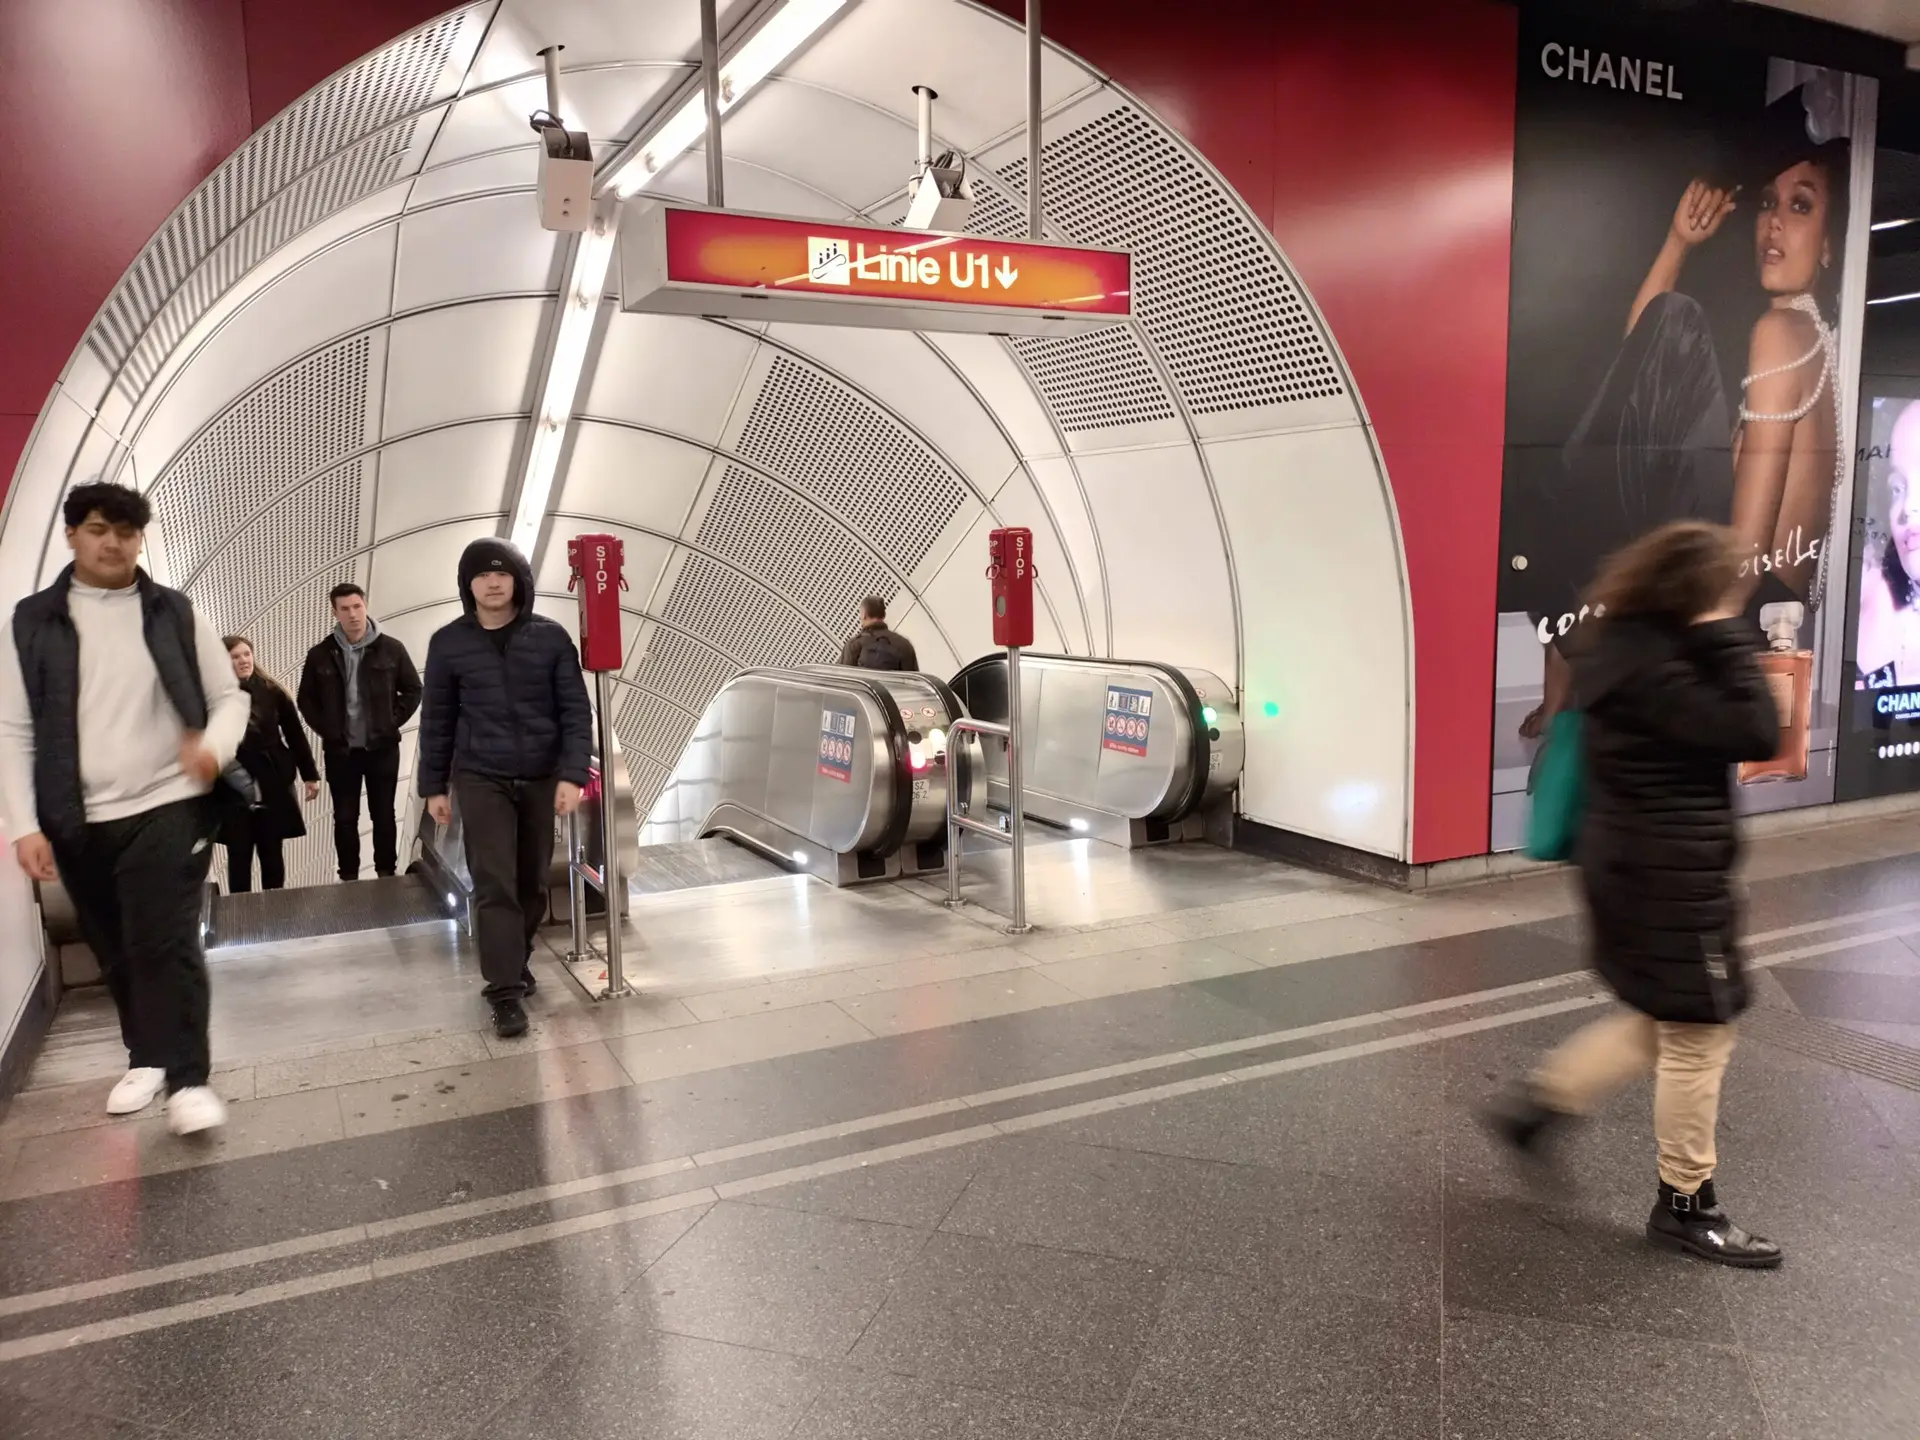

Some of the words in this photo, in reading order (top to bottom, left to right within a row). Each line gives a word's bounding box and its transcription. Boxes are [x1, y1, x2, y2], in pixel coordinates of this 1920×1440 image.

[1541, 42, 1683, 100] CHANEL
[857, 243, 940, 285] Linie
[950, 251, 989, 288] U1
[596, 545, 608, 594] STOP
[1016, 536, 1025, 579] STOP
[1877, 692, 1920, 713] CHAN
